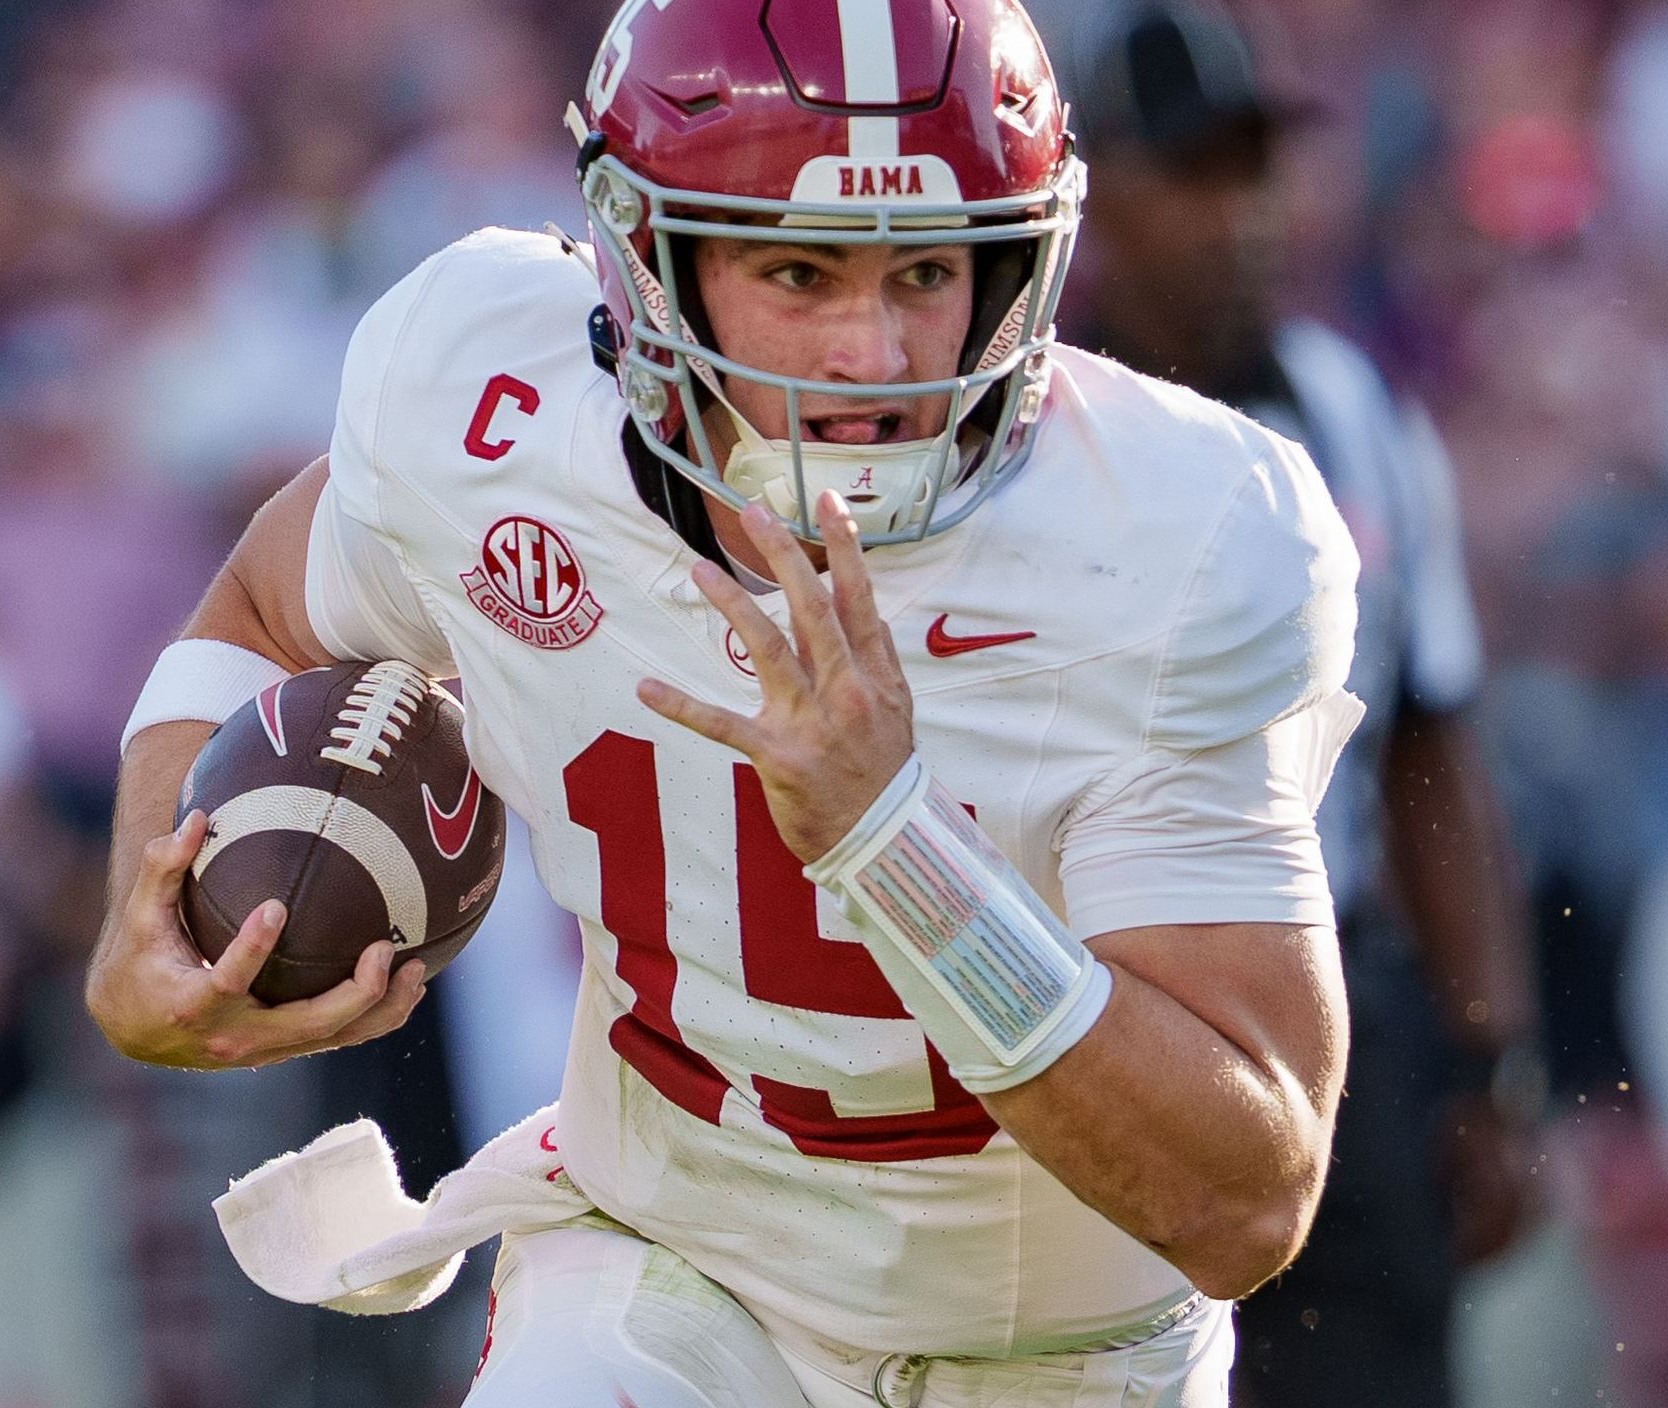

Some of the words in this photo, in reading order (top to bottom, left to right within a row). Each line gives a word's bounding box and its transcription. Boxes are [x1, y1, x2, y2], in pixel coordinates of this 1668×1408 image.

[839, 165, 923, 196] BAMA
[623, 247, 683, 329] CRIMSO
[463, 373, 540, 461] C
[487, 520, 573, 615] SEC
[479, 594, 584, 646] GRADUATE
[563, 729, 1001, 1162] 15
